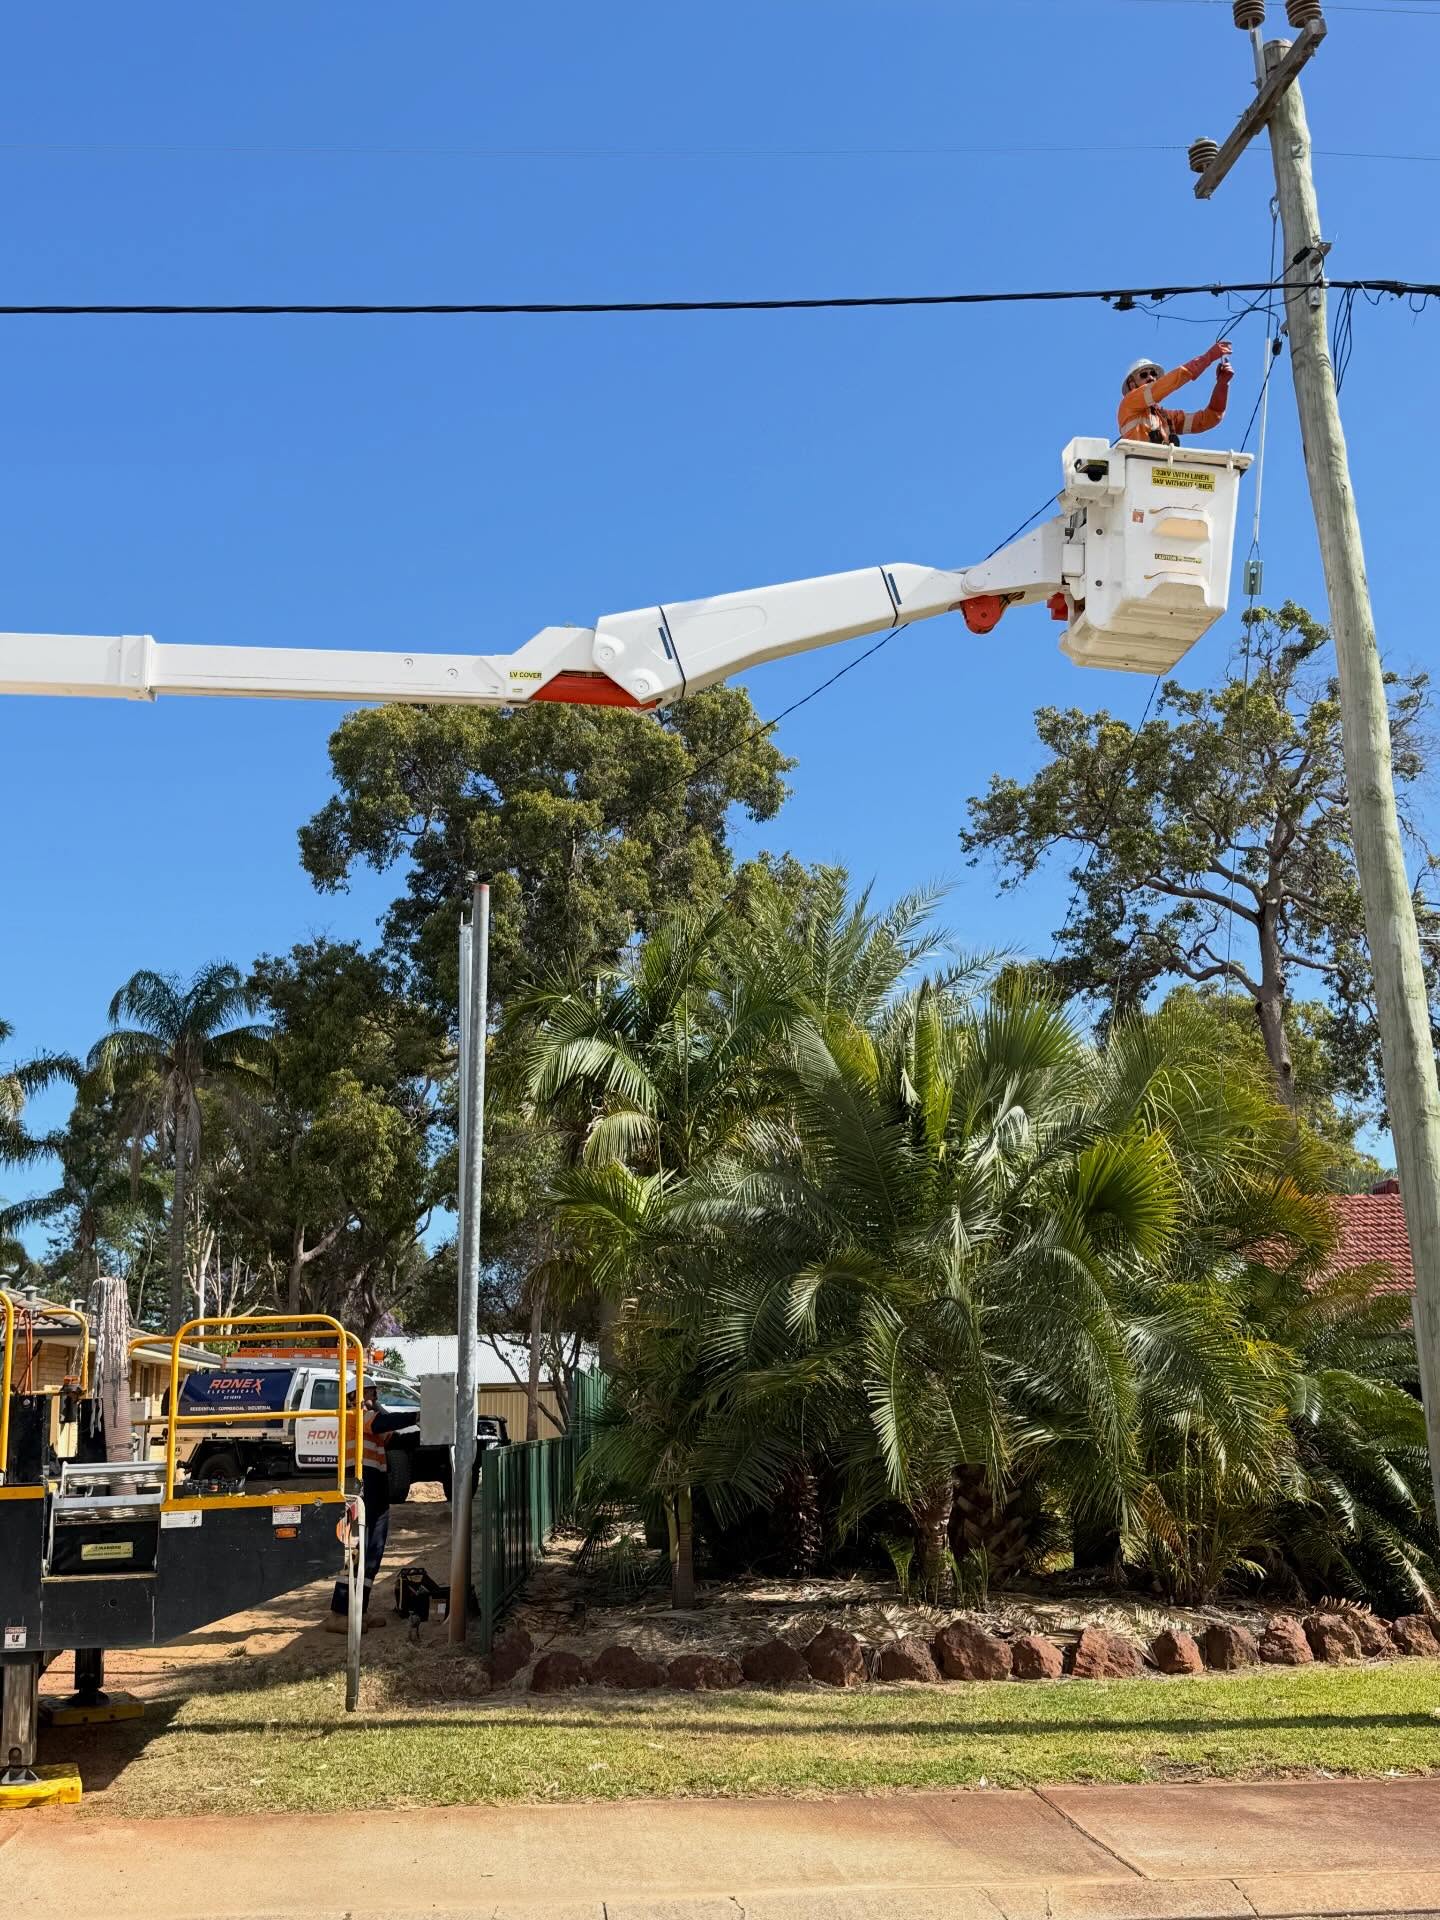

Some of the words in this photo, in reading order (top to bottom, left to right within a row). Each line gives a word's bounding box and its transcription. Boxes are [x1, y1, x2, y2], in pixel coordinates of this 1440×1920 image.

[1172, 471, 1190, 479] WITH
[1164, 479, 1193, 488] WITHOUT
[519, 671, 542, 679] COVER
[209, 1378, 265, 1395] RONEX
[307, 1430, 338, 1440] RON
